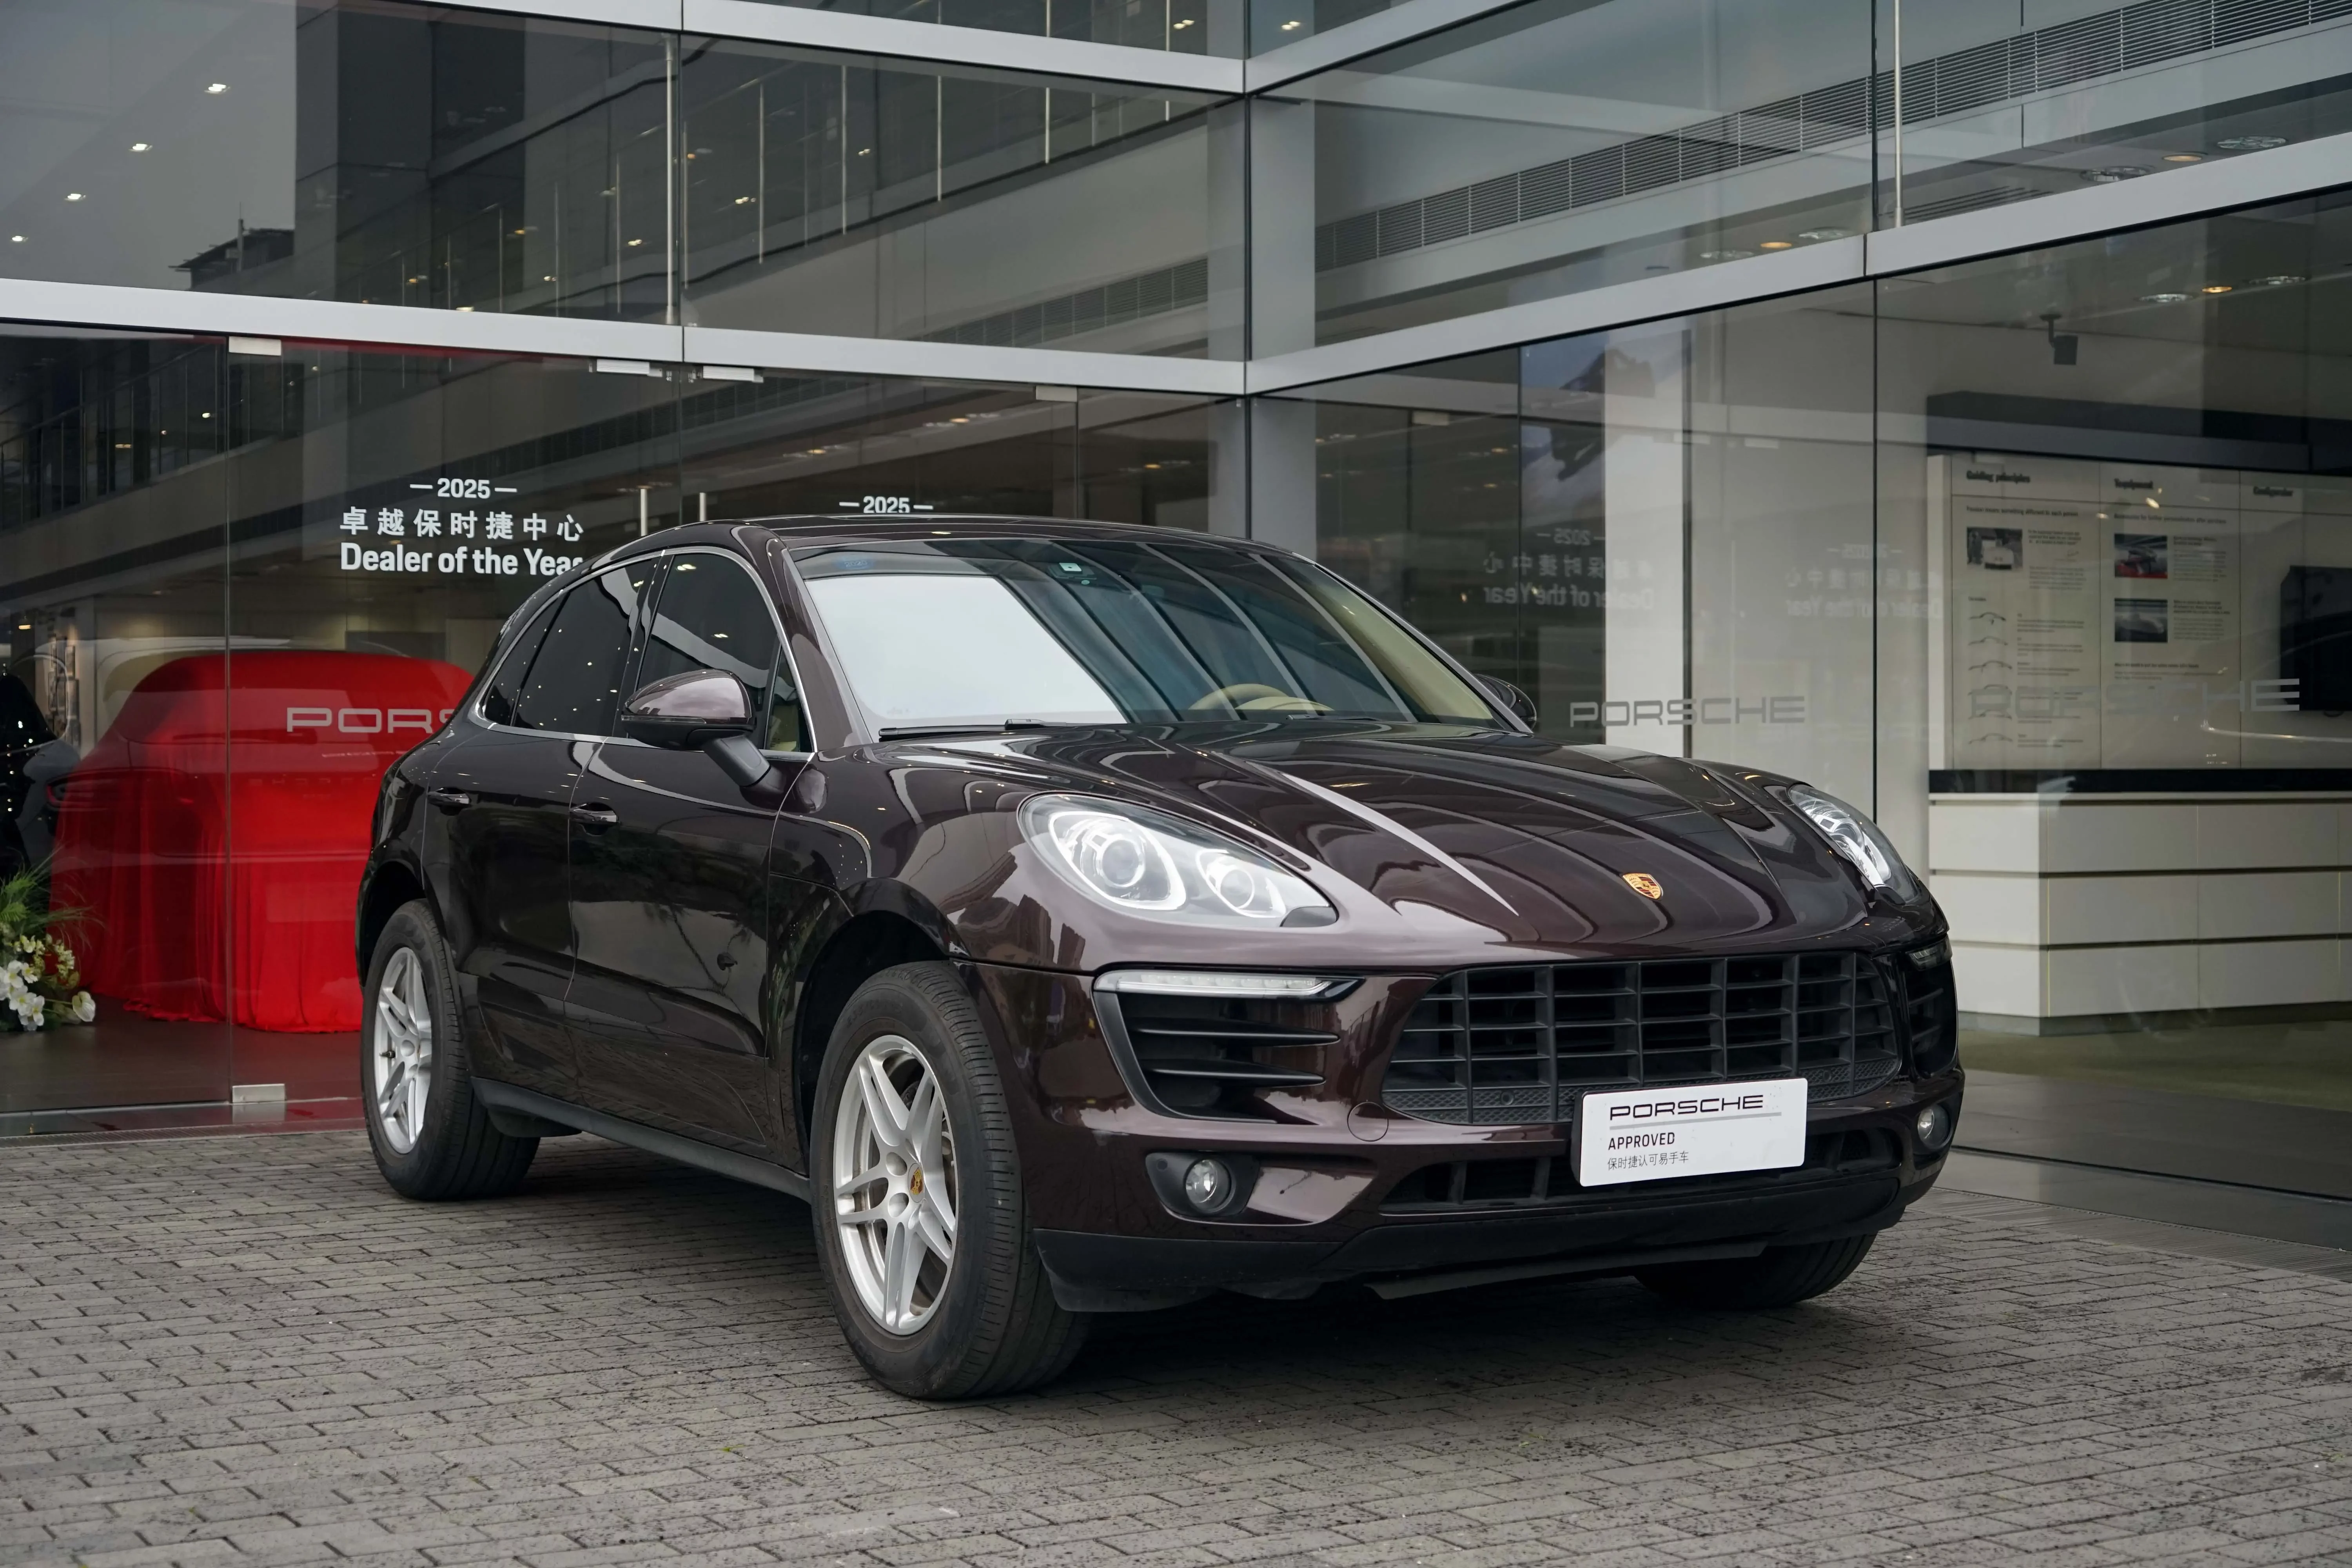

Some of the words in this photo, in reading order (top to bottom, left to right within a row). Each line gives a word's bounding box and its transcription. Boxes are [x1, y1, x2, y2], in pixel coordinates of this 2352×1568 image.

[437, 477, 490, 499] 2025
[863, 496, 910, 514] 2025
[340, 506, 584, 542] 卓越保时捷中心
[341, 542, 432, 573] Dealer
[438, 546, 467, 573] of
[472, 547, 518, 575] the
[1570, 695, 1806, 728] PORSCHE
[1971, 678, 2300, 718] PORSCHE
[1609, 1094, 1764, 1121] PORSCHE
[1608, 1132, 1675, 1151] APPROVED
[1607, 1151, 1689, 1171] 保时捷认可易手车
